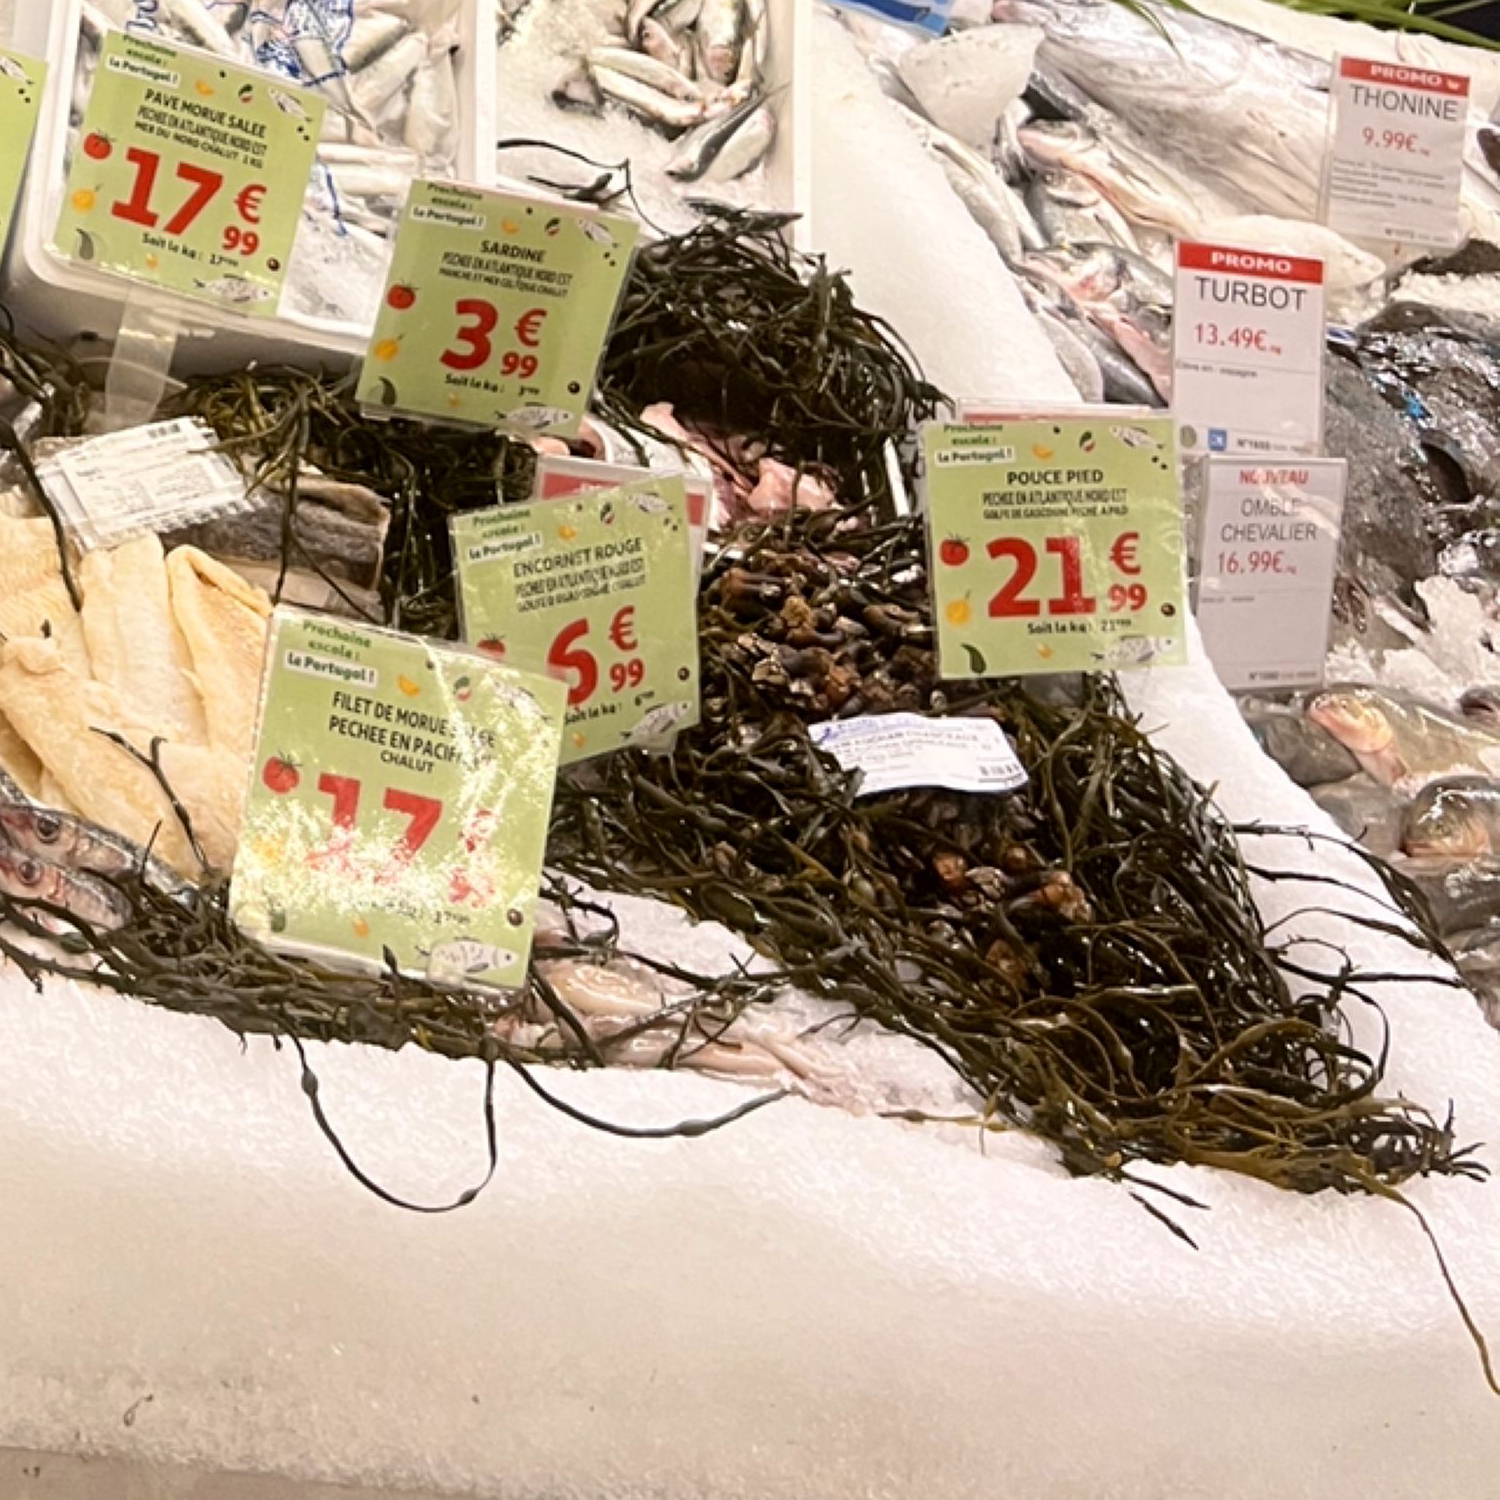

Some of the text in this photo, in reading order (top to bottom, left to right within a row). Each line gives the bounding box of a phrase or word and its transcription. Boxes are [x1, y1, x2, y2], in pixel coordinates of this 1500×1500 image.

[1370, 63, 1443, 88] PROMO
[144, 88, 267, 139] PAVE MORUE SALEE
[1348, 83, 1460, 122] THONINE
[110, 145, 268, 258] 17 € 99
[479, 239, 547, 264] SARDINE
[1210, 251, 1293, 275] PROMO
[1194, 275, 1308, 312] TURBOT
[439, 297, 548, 380] 3 € 99
[1006, 469, 1104, 486] POUCE PIED
[1219, 522, 1319, 543] CHEVALIER
[513, 536, 643, 578] ENCORNET ROUGE
[985, 531, 1148, 618] 21 € 99
[609, 604, 639, 653] €
[1026, 621, 1052, 635] Soit
[303, 656, 367, 682] Portugal
[608, 656, 646, 694] 99
[328, 713, 387, 747] PECHEE
[389, 729, 411, 751] EN
[331, 690, 450, 737] FILET DE MORUE
[379, 749, 436, 775] CHALUT
[305, 771, 443, 886] 17
